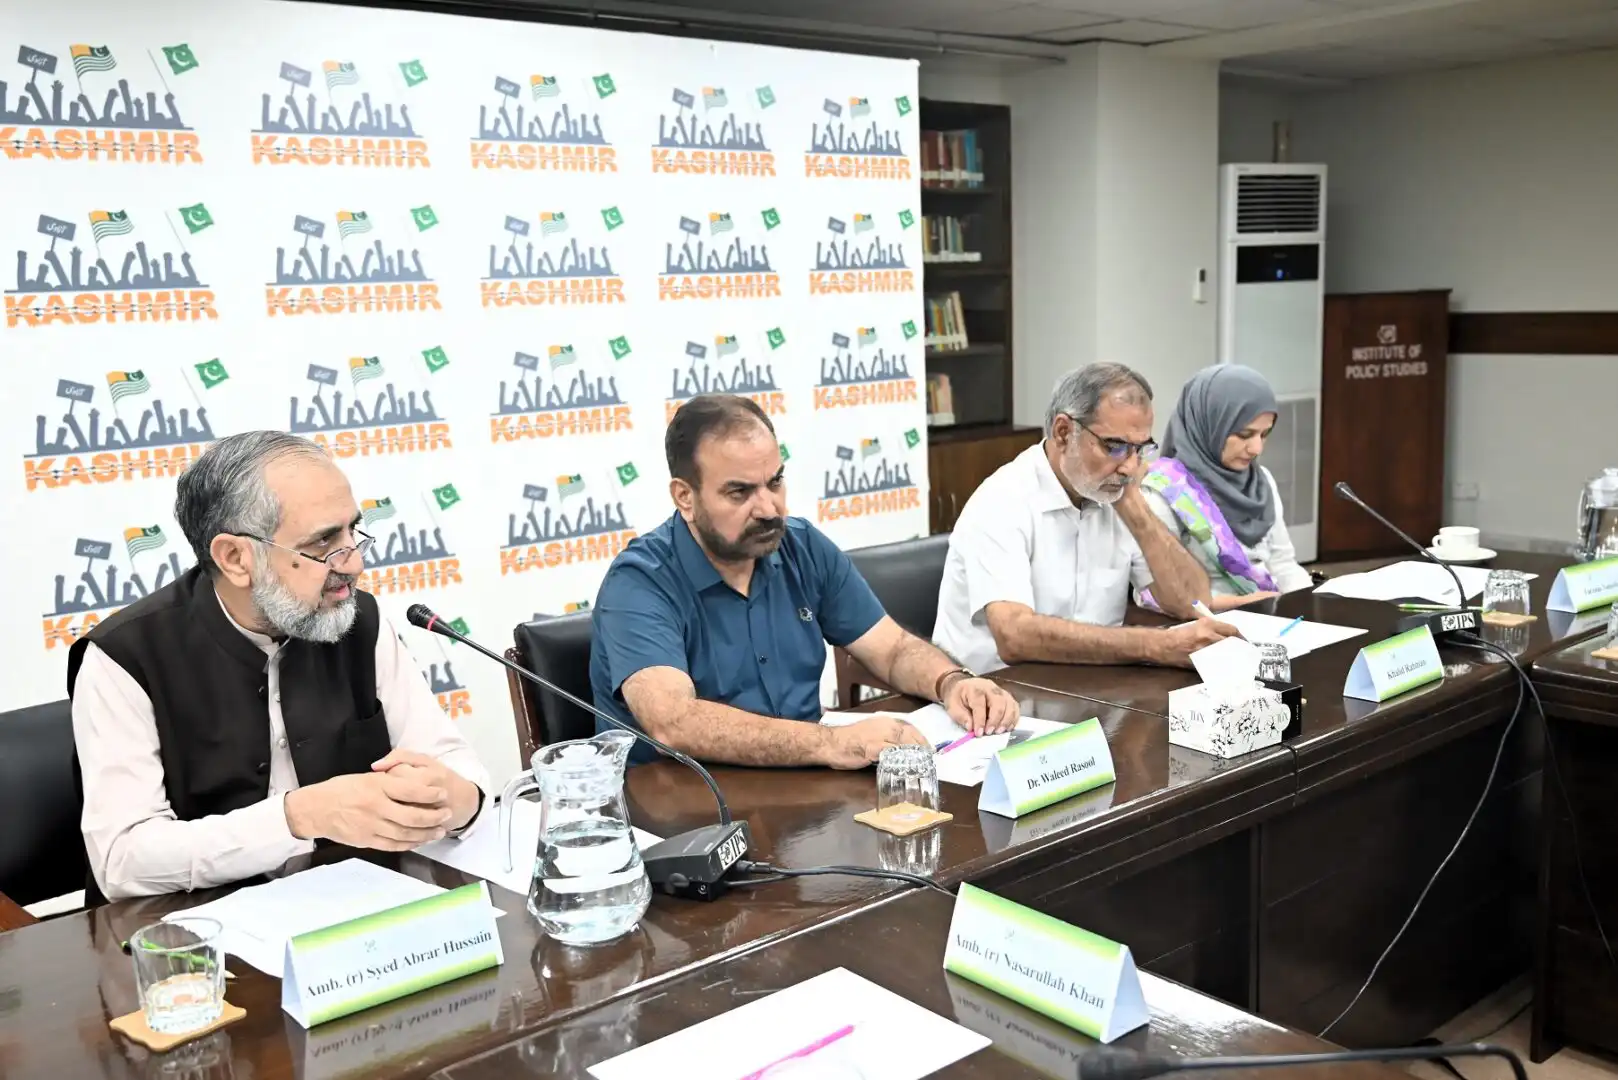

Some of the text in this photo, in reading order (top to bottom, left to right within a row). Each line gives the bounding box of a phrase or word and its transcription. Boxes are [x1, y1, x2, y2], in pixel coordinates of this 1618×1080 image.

[251, 135, 430, 168] KASHMIR
[470, 143, 618, 173] KASHMIR
[651, 149, 776, 177] KASHMIR
[805, 154, 911, 181] KASHMIR
[481, 278, 625, 307] KASHMIR
[658, 272, 781, 301] KASHMIR
[809, 270, 914, 295] KASHMIR
[4, 288, 219, 329] KASHMIR
[266, 283, 442, 318] KASHMIR
[1352, 343, 1422, 361] INSTITUTE OF
[1345, 361, 1428, 379] POLICY STUDIES
[813, 379, 917, 410] KASHMIR
[491, 406, 633, 445] KASHMIR
[817, 488, 920, 523] KASHMIR
[1456, 613, 1475, 628] IPS
[1027, 756, 1096, 790] Dr. Waleed Rasool
[305, 930, 492, 998] Amb. (r) Syed Abrar Hussain
[956, 934, 1105, 1009] Amb. (r) Nasarullah Khan
